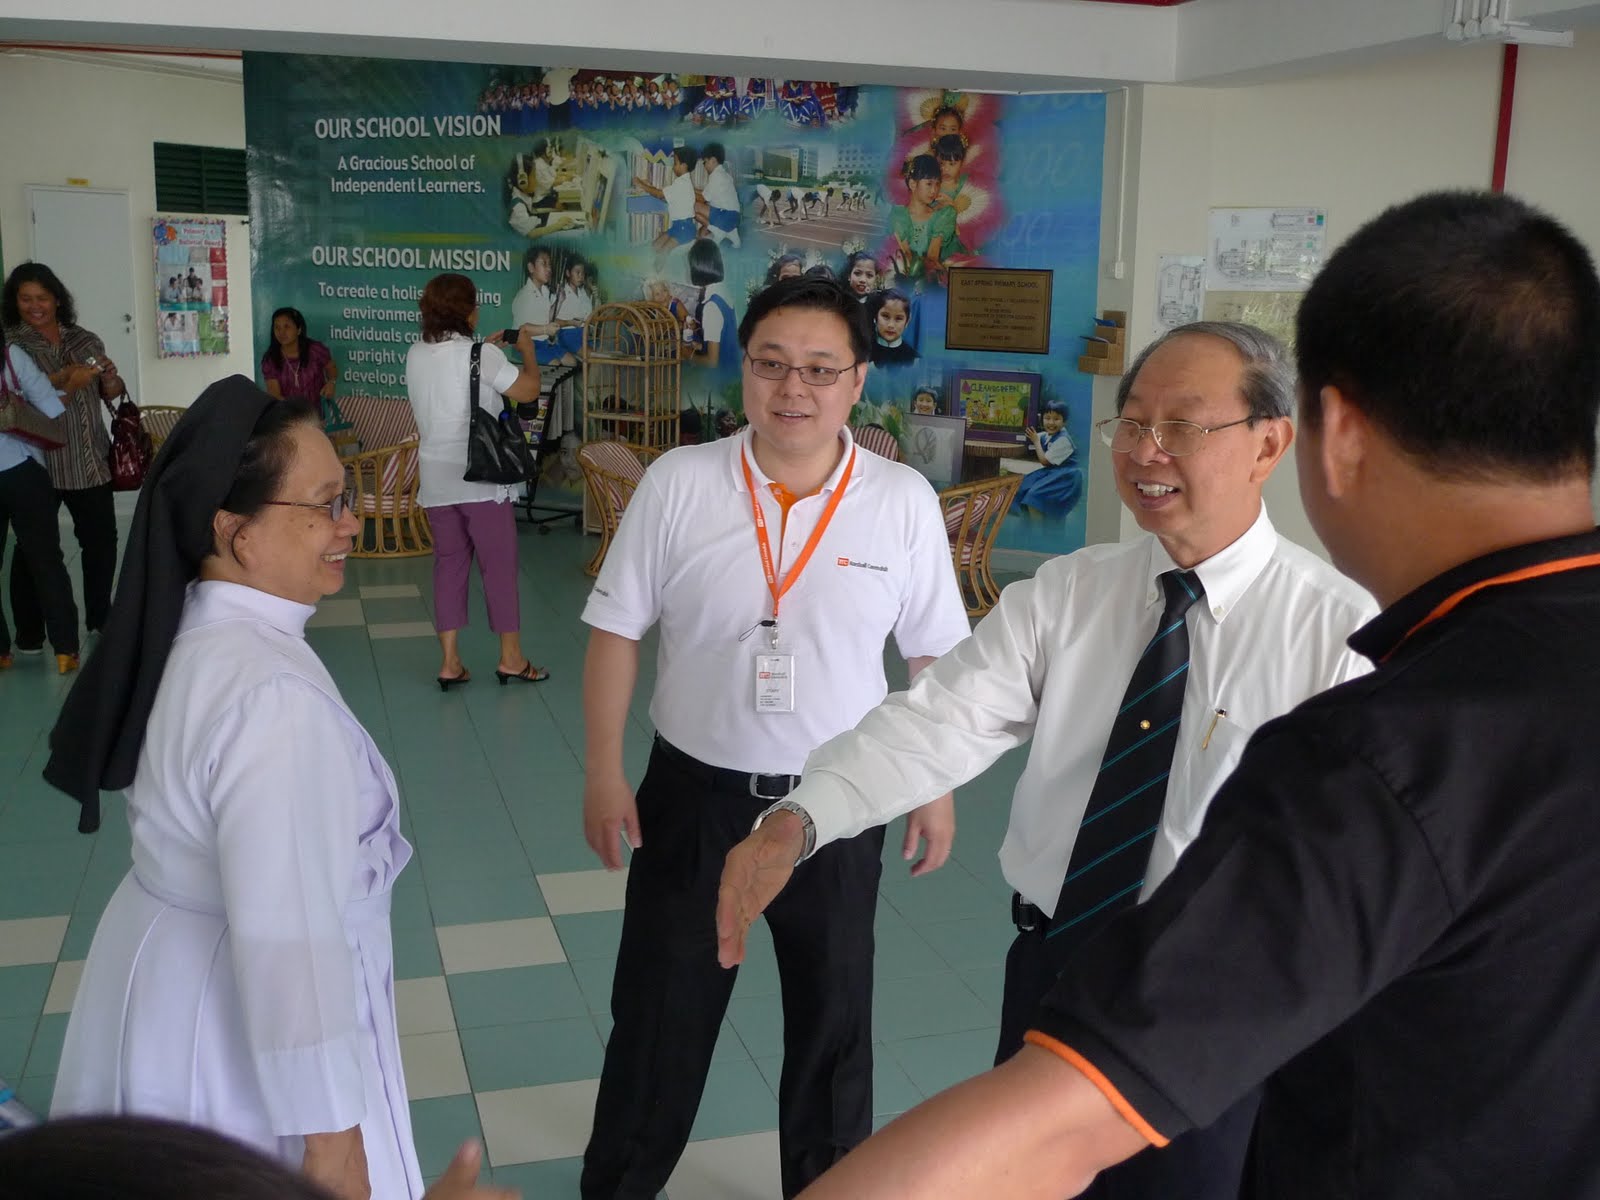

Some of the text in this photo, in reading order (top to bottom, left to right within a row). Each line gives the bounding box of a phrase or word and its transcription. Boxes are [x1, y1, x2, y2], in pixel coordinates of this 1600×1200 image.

[315, 114, 501, 138] OUR SCHOOL VISION
[338, 154, 475, 171] A Gracious School of
[331, 177, 486, 195] Independent Learners.
[312, 246, 511, 271] OUR SCHOOL MISSION
[318, 282, 423, 301] To create a holis
[1018, 281, 1039, 289] SCHOOL
[343, 306, 423, 322] environmen
[330, 326, 400, 342] individuals
[349, 349, 395, 365] upright
[344, 369, 397, 386] develop
